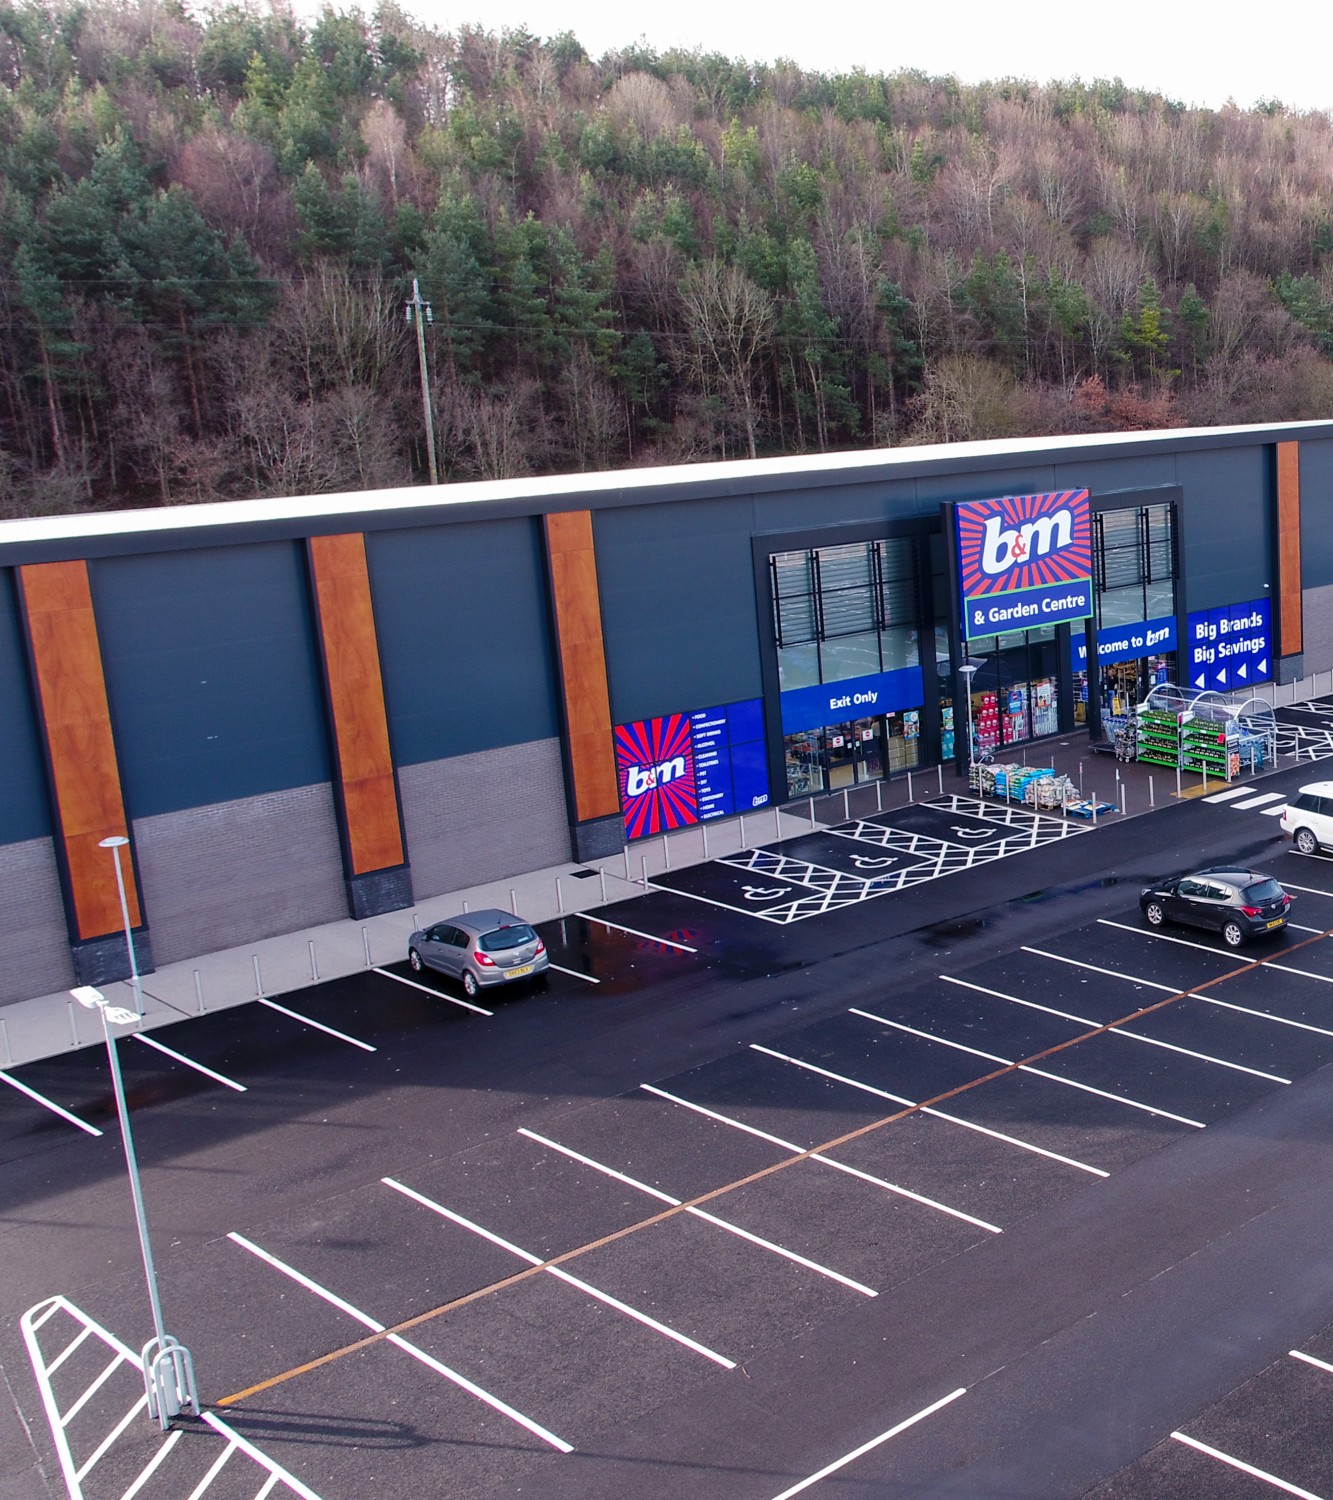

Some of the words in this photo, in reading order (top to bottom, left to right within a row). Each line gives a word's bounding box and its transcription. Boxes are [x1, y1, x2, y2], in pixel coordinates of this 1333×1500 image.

[974, 610, 985, 625] &
[988, 602, 1038, 622] Garden
[1042, 595, 1085, 613] Centre
[1195, 623, 1216, 640] Big
[1220, 611, 1263, 633] Brands
[1130, 635, 1143, 648] to
[1194, 647, 1215, 664] Big
[1218, 635, 1266, 658] Savings
[830, 695, 851, 709] Exit
[853, 690, 878, 704] Only
